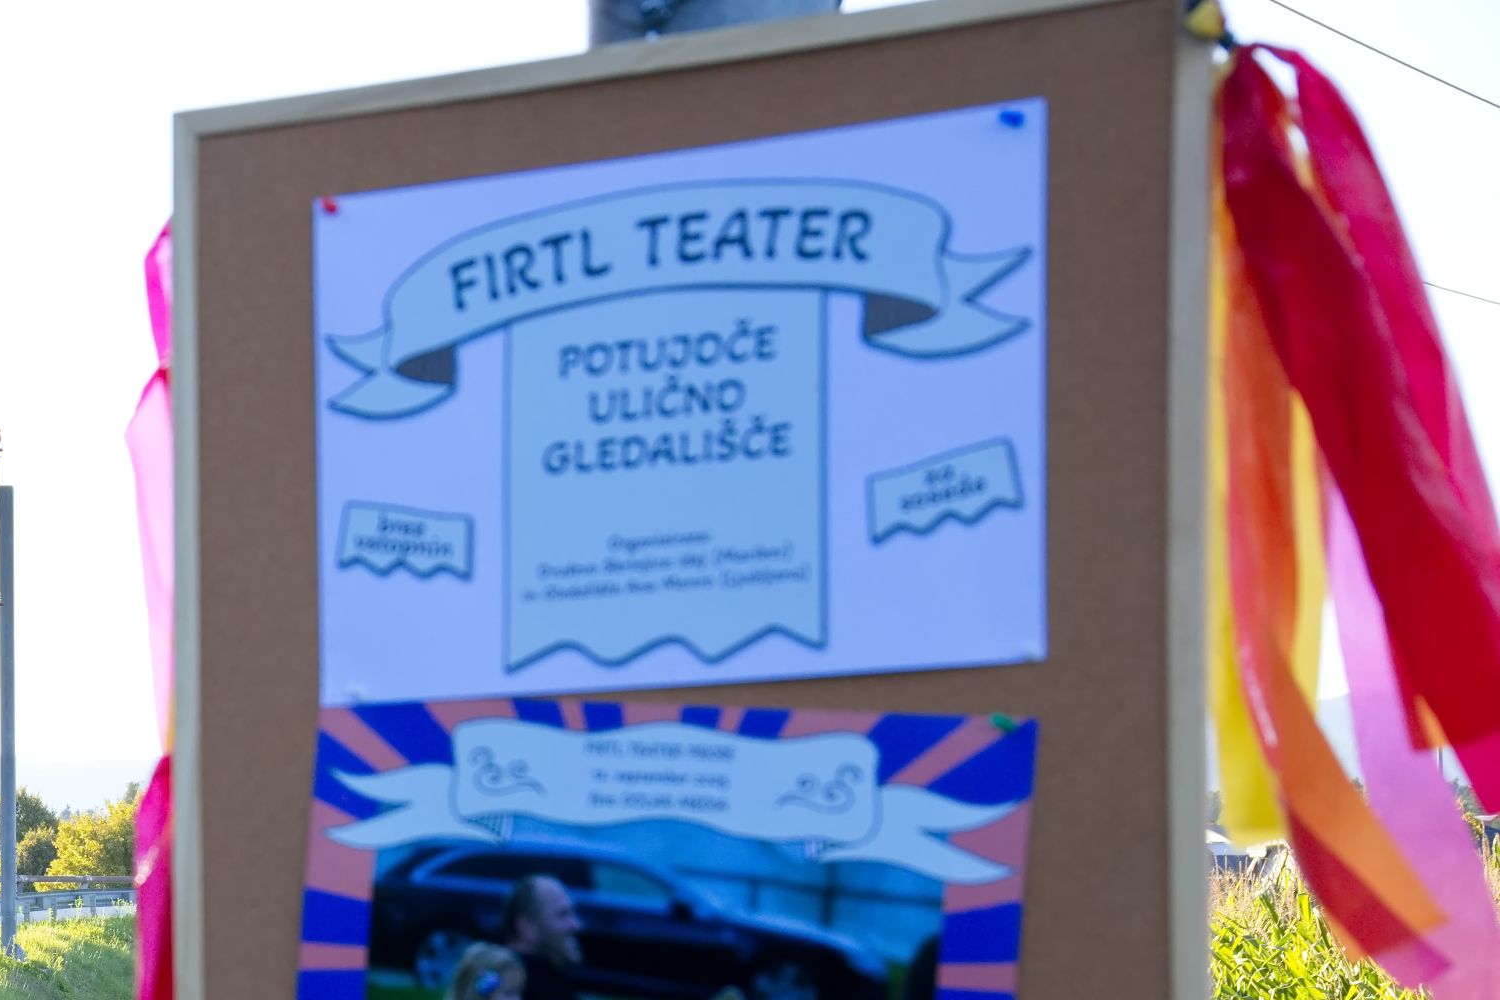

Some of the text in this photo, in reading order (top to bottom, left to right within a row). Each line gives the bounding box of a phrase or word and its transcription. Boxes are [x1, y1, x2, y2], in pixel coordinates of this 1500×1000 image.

[449, 206, 873, 311] FIRTL TEATER
[557, 318, 779, 379] POTUJOČE
[588, 375, 747, 425] ULIČNO
[541, 419, 793, 476] GLEDALIŠČE
